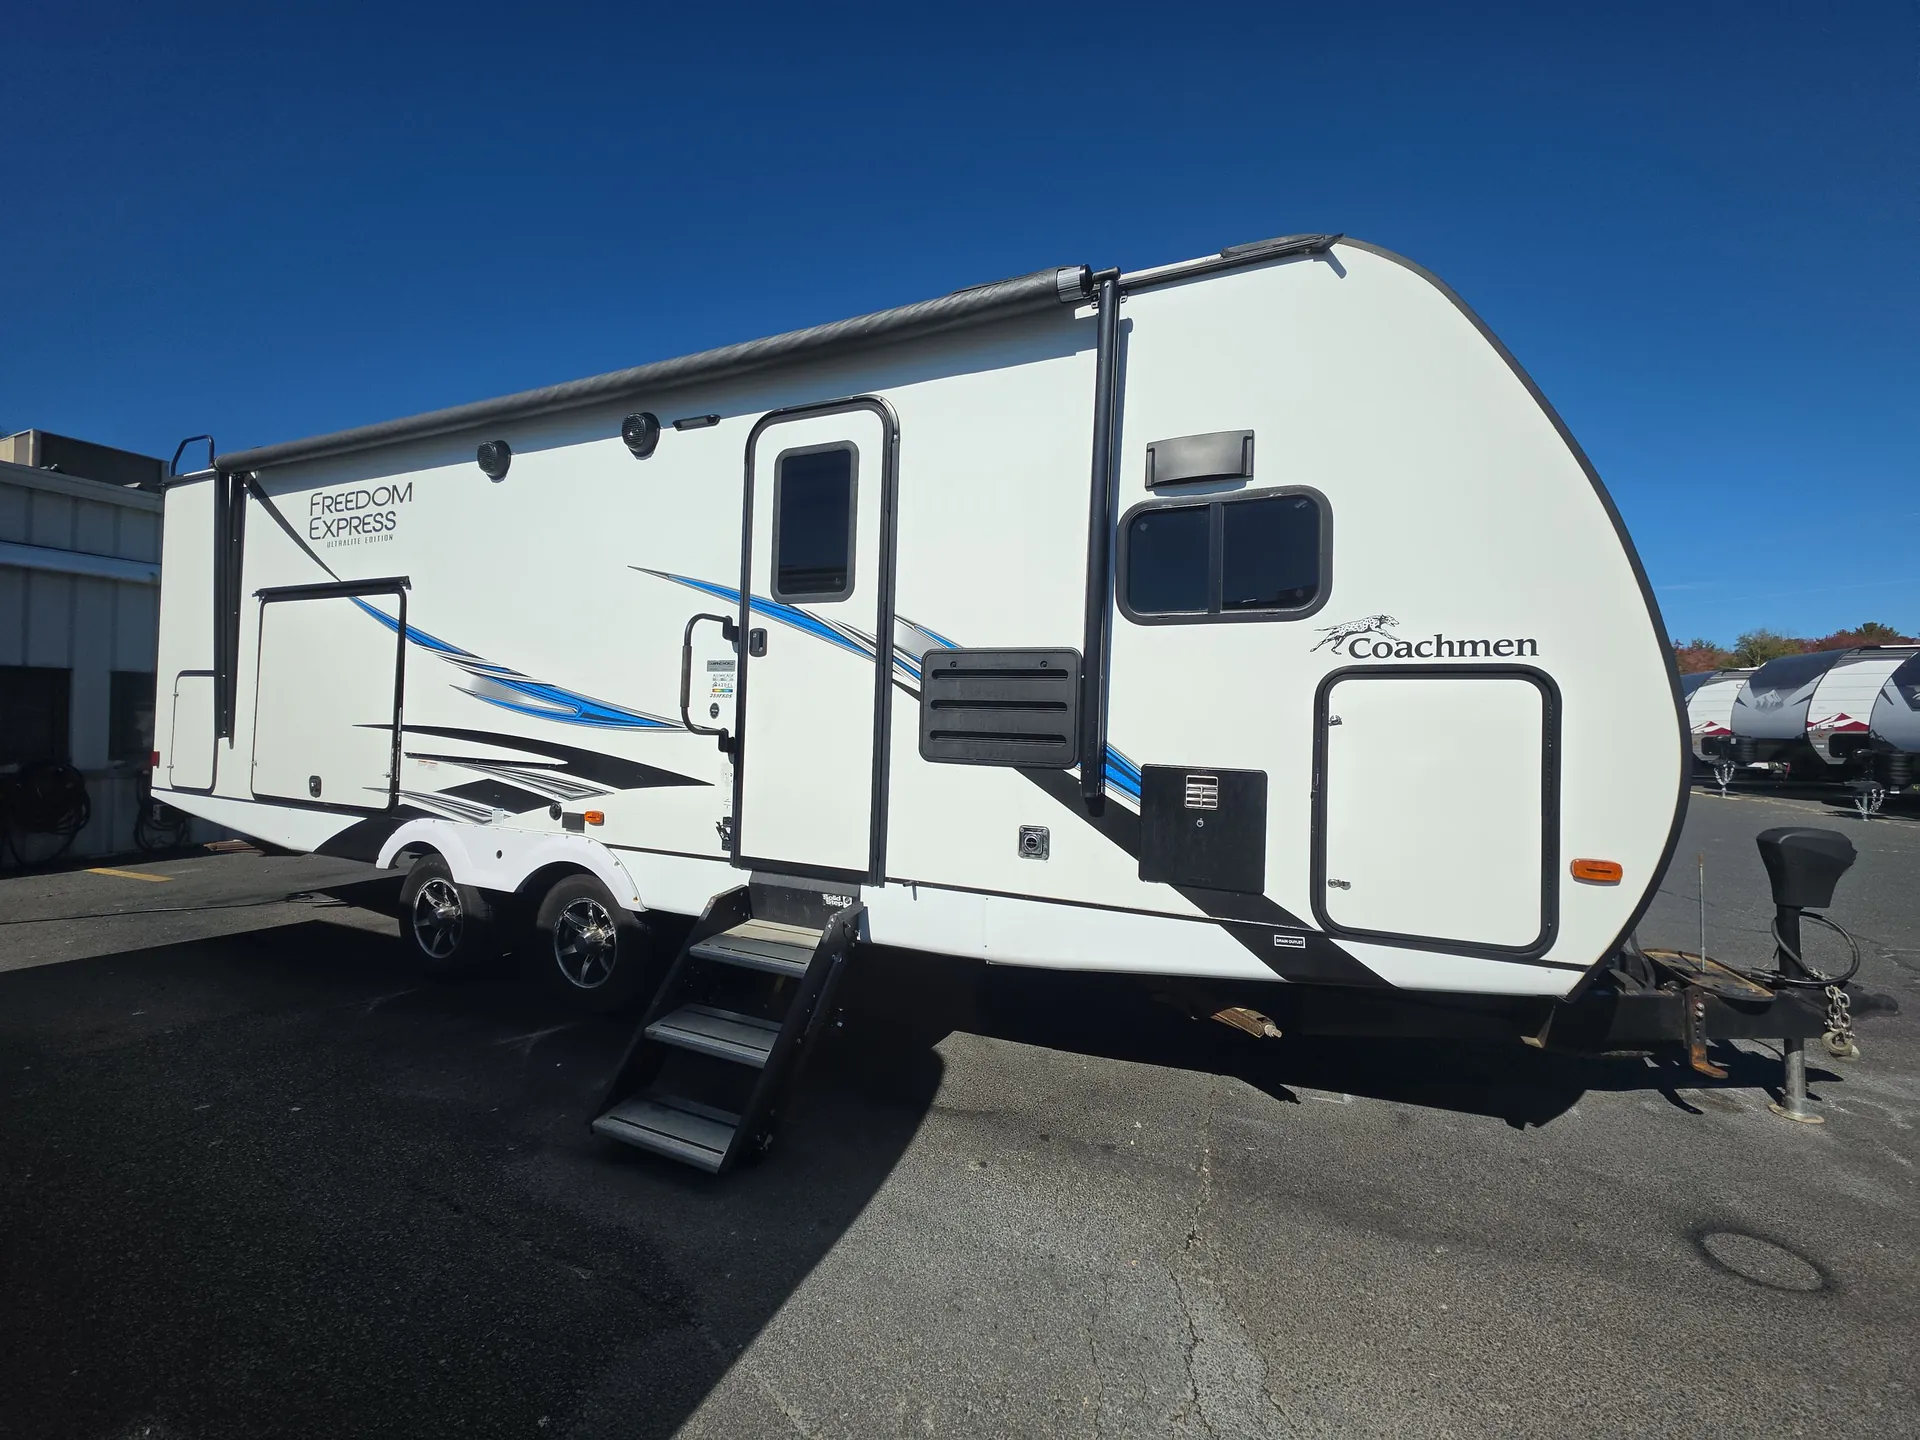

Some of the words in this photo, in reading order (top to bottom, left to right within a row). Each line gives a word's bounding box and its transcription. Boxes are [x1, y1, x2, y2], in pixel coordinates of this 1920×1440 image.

[310, 482, 413, 516] FREEDOM
[309, 511, 397, 540] EXPRESS
[326, 538, 361, 548] ULTRALITE
[365, 534, 394, 544] EDITION
[1348, 633, 1540, 659] Coachmen
